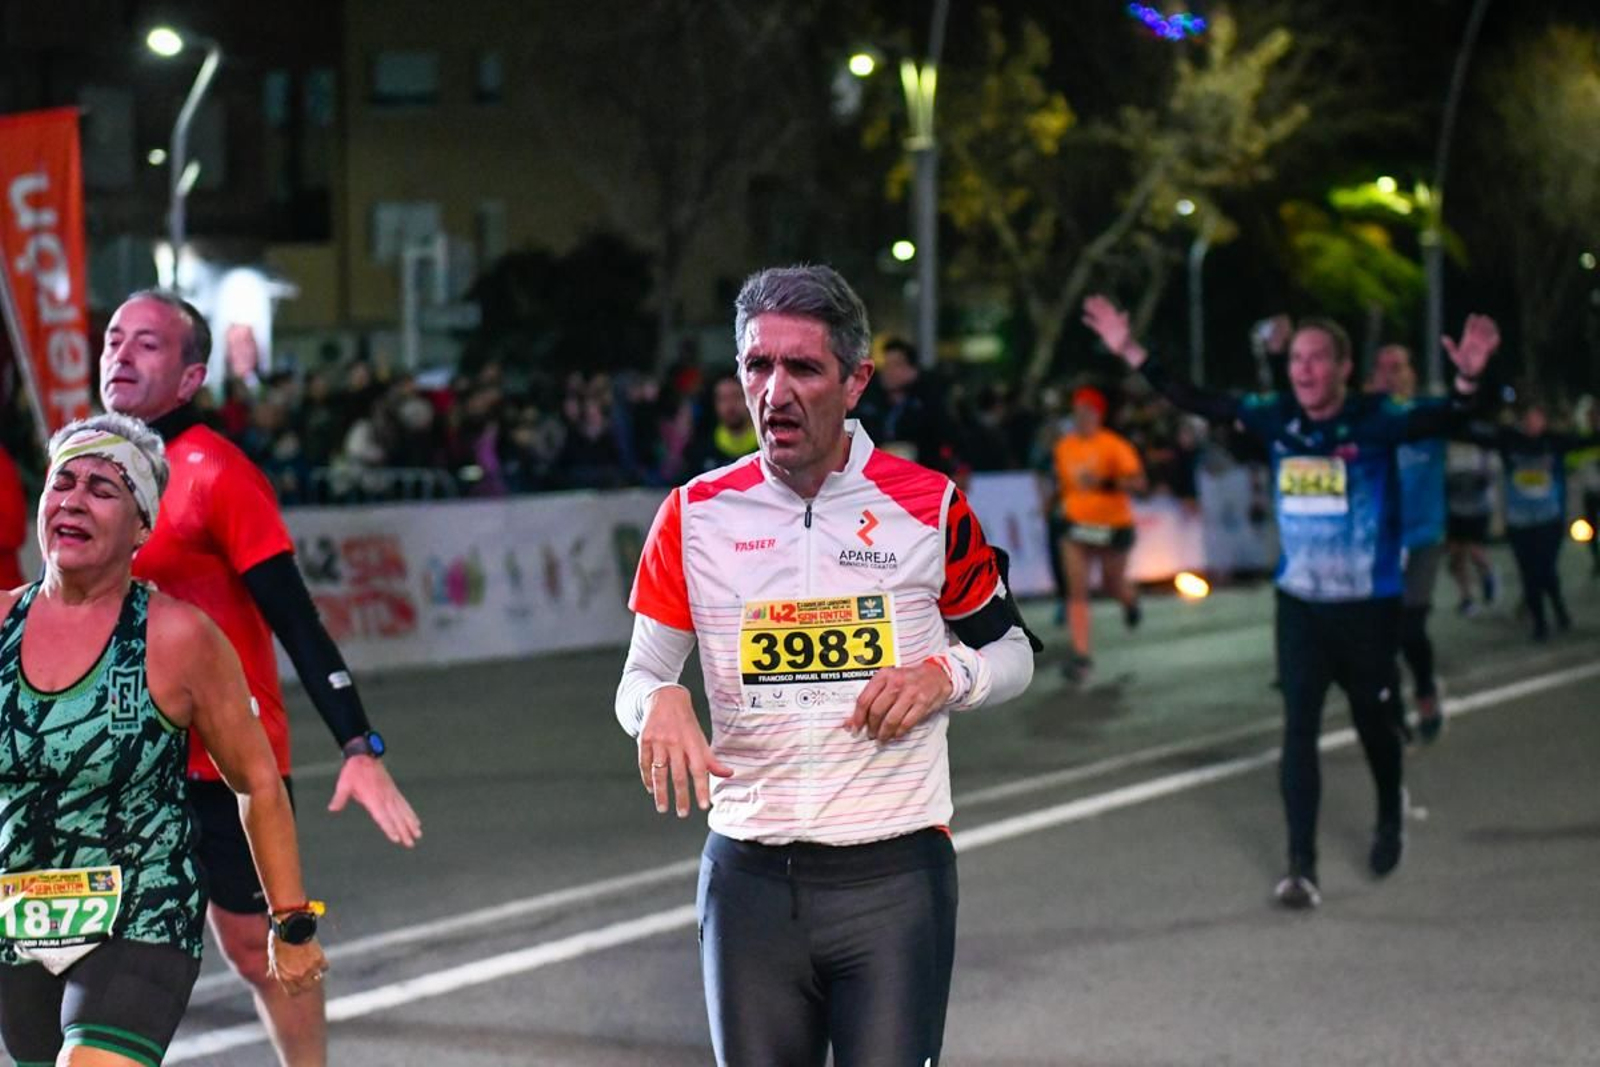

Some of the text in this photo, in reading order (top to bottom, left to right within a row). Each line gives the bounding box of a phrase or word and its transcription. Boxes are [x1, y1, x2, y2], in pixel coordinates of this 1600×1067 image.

[735, 538, 776, 552] FASTER
[839, 550, 897, 564] APAREJA
[770, 602, 798, 623] 42
[751, 627, 883, 671] 3983
[758, 674, 793, 682] FRANCISCO
[795, 672, 819, 681] MIGUEL
[820, 671, 841, 680] REYES
[5, 897, 109, 938] 1872
